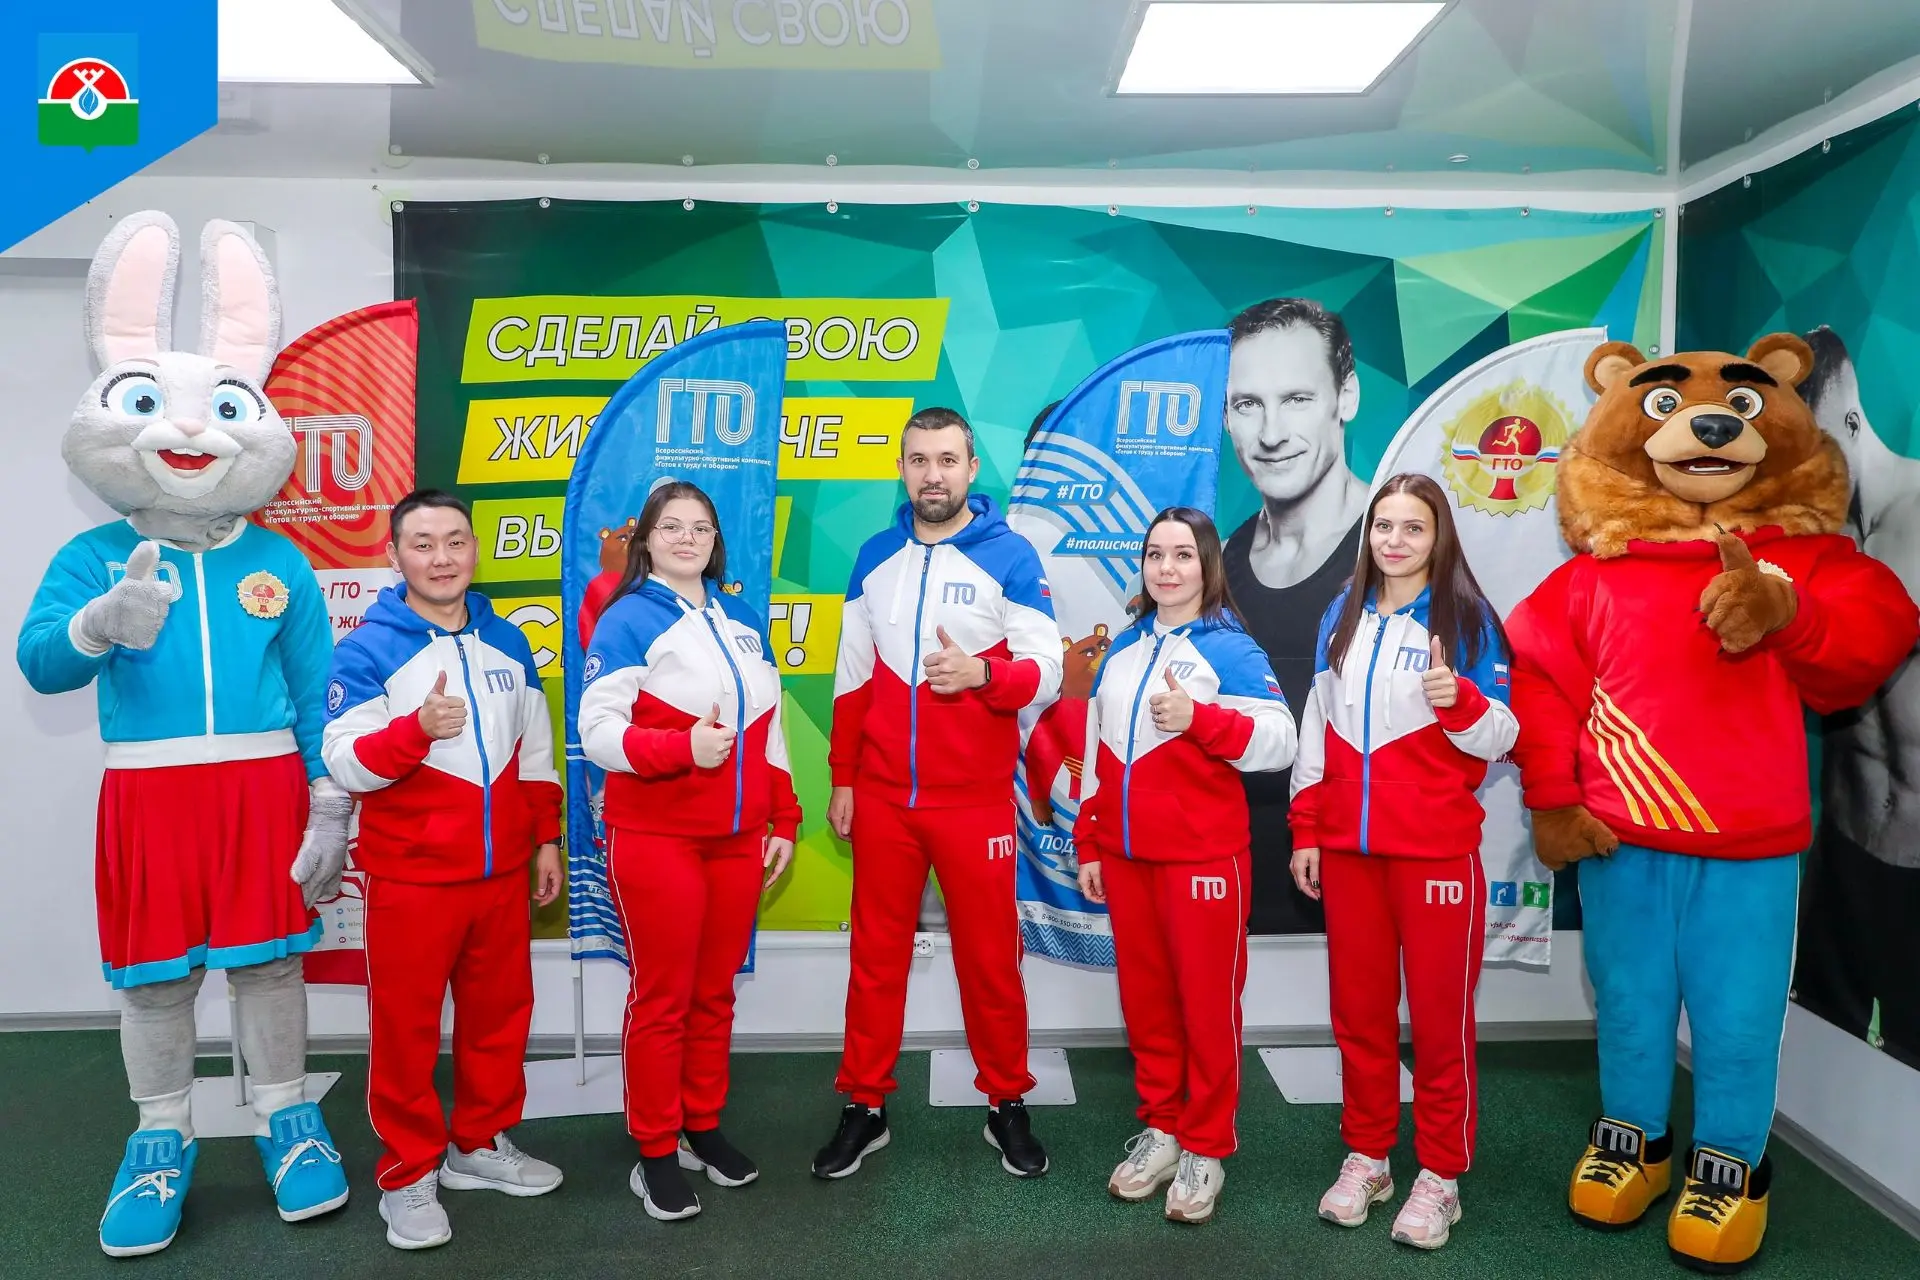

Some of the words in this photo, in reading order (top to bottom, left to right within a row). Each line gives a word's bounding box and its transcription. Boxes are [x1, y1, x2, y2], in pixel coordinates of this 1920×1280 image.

[745, 316, 919, 362] ВОЮ
[656, 378, 755, 446] ГТО
[1117, 380, 1201, 437] ГТО
[779, 415, 843, 458] ЧЕ
[281, 413, 373, 492] ТО
[656, 447, 704, 455] Всероссийский
[741, 457, 772, 466] комплекс
[1492, 458, 1523, 471] ГТО
[1056, 483, 1104, 500] #ГТО
[299, 514, 322, 523] труду
[362, 503, 396, 511] комплек
[330, 581, 361, 599] ГТО
[943, 582, 976, 605] ГТО
[735, 634, 762, 653] ГТО
[1393, 646, 1430, 673] ГТО
[484, 669, 515, 694] ГТО
[988, 834, 1014, 860] ГТО
[1039, 834, 1078, 857] ПОД
[1191, 876, 1227, 900] ГТО
[1425, 880, 1463, 905] ГТО
[1596, 1120, 1639, 1155] ГТО
[1695, 1152, 1743, 1190] ГТО
